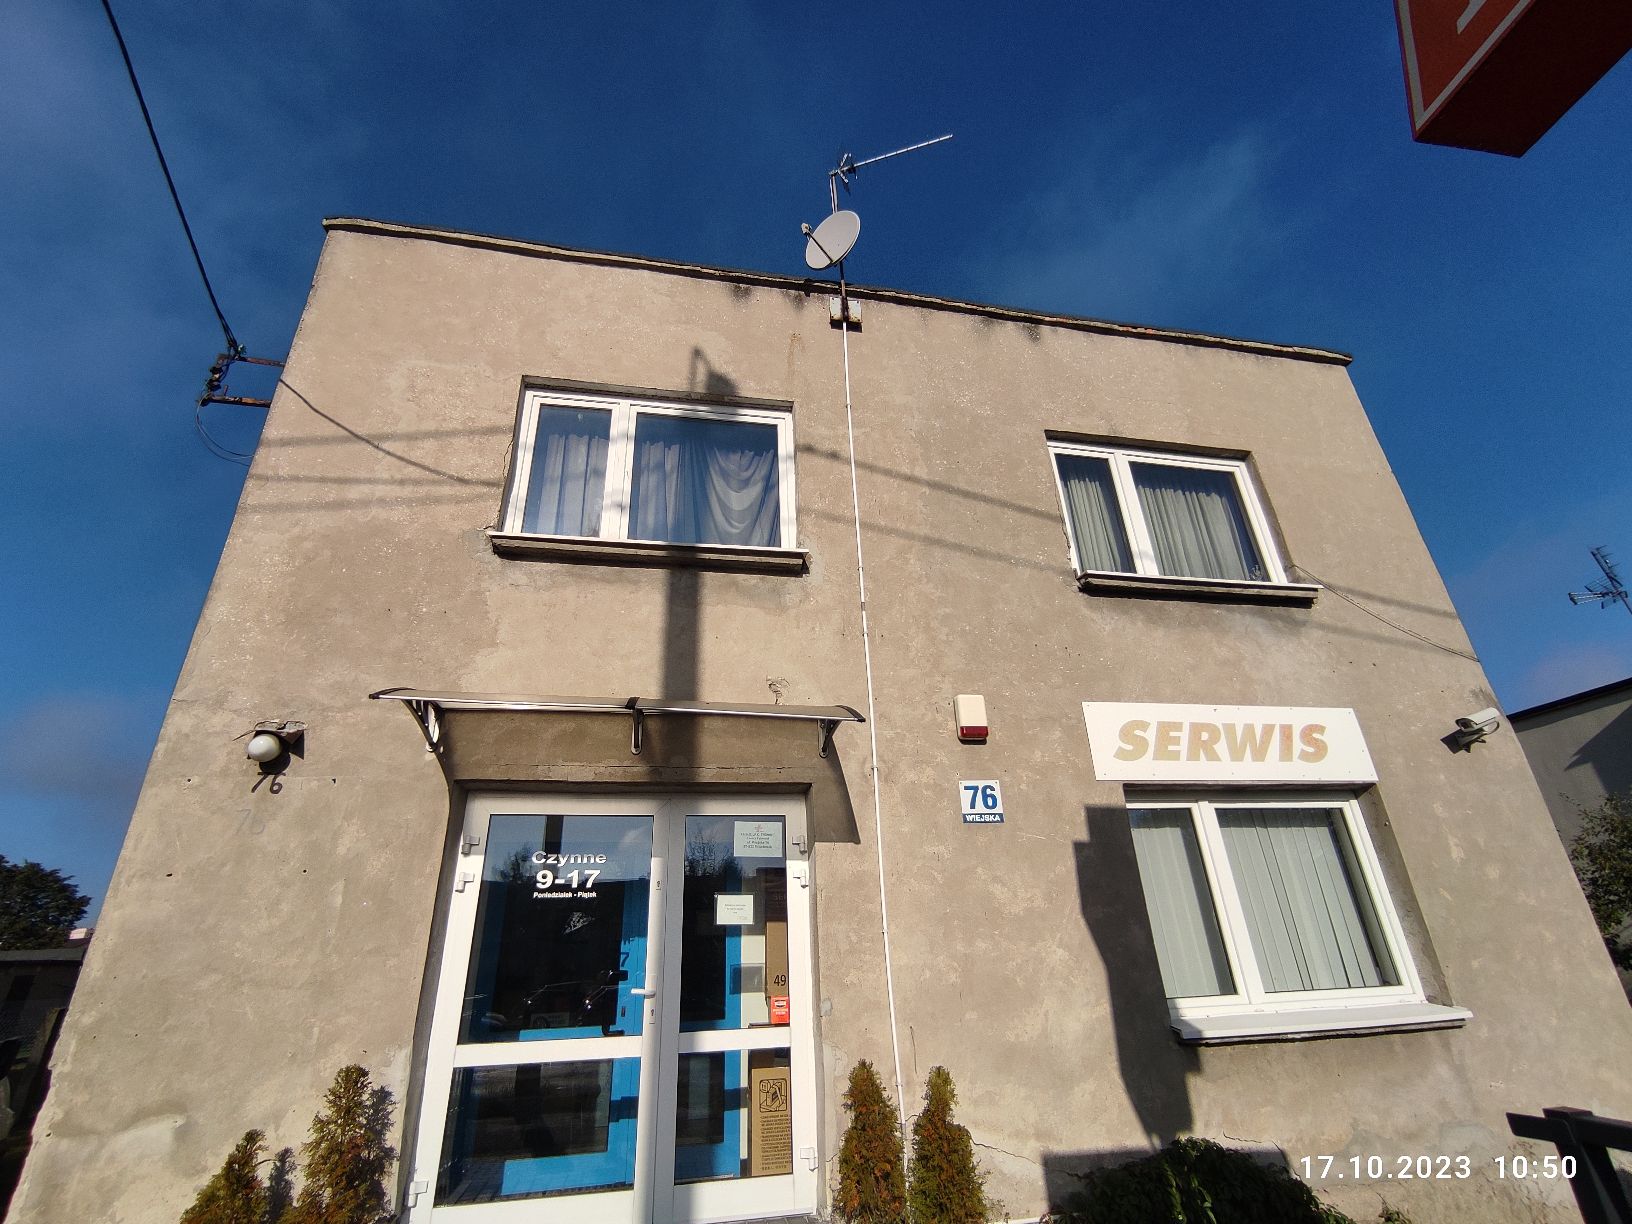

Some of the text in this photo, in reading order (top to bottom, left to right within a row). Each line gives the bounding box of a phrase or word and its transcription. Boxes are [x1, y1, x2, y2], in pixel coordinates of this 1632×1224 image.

[1113, 719, 1328, 763] SERWIS
[963, 785, 998, 810] 76
[965, 814, 1001, 822] WIEJSKA
[532, 851, 607, 867] Czynne
[536, 869, 601, 889] 9-17
[773, 974, 787, 987] 49
